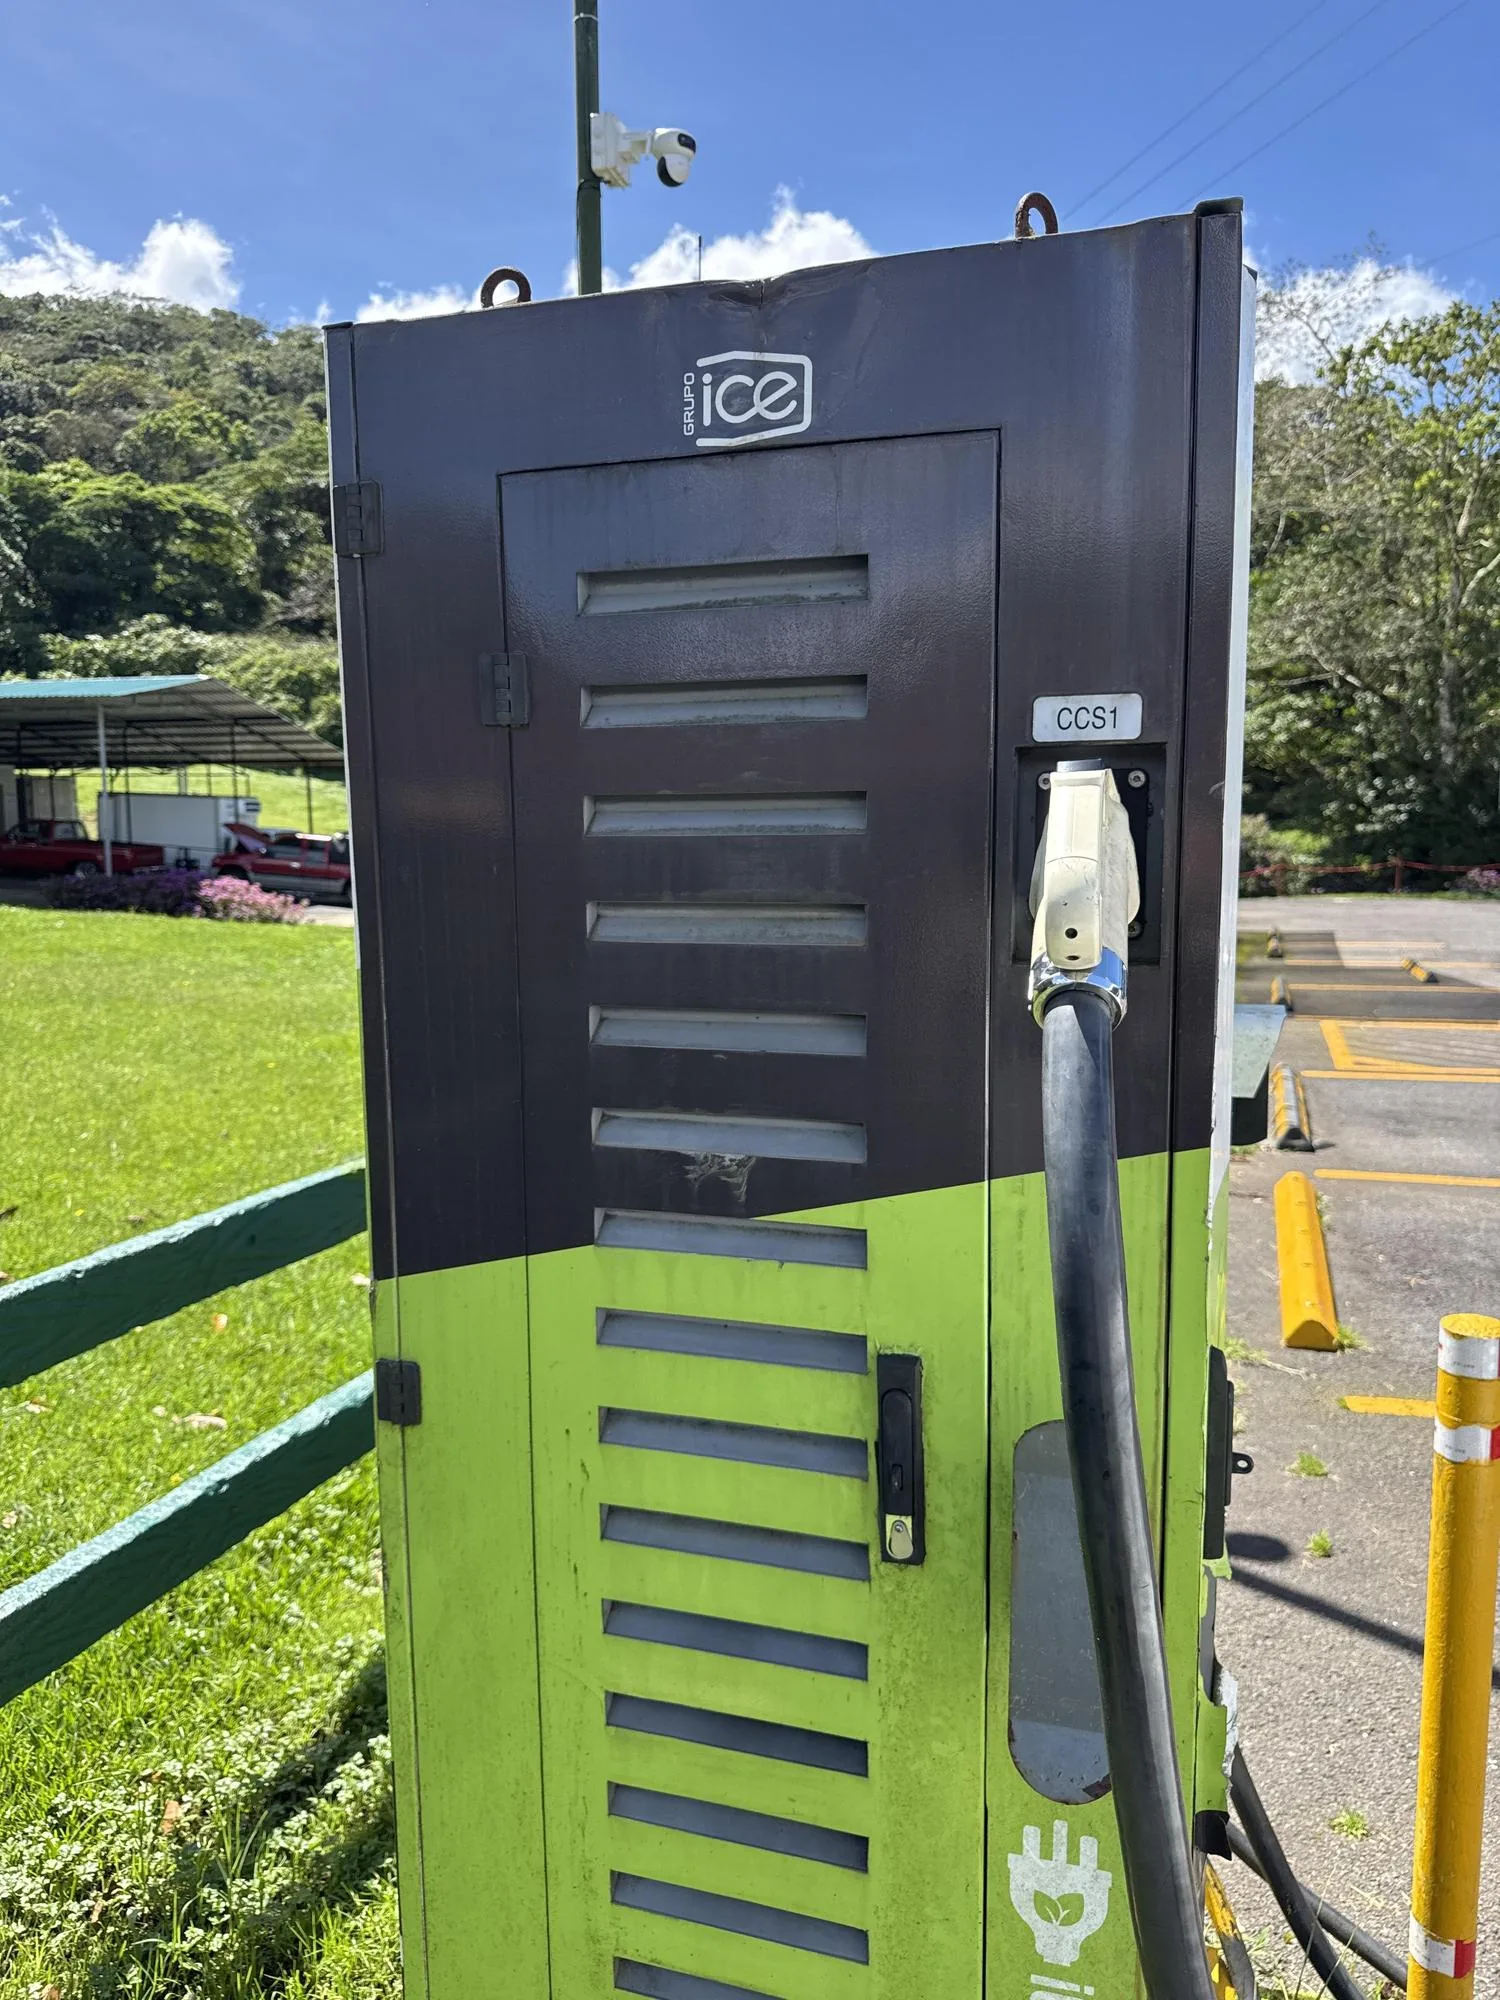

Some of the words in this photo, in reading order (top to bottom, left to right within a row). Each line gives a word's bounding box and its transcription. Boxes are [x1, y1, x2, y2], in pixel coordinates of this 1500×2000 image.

[683, 372, 695, 436] GRUPO
[702, 371, 798, 427] ice
[1056, 705, 1118, 731] CCS1
